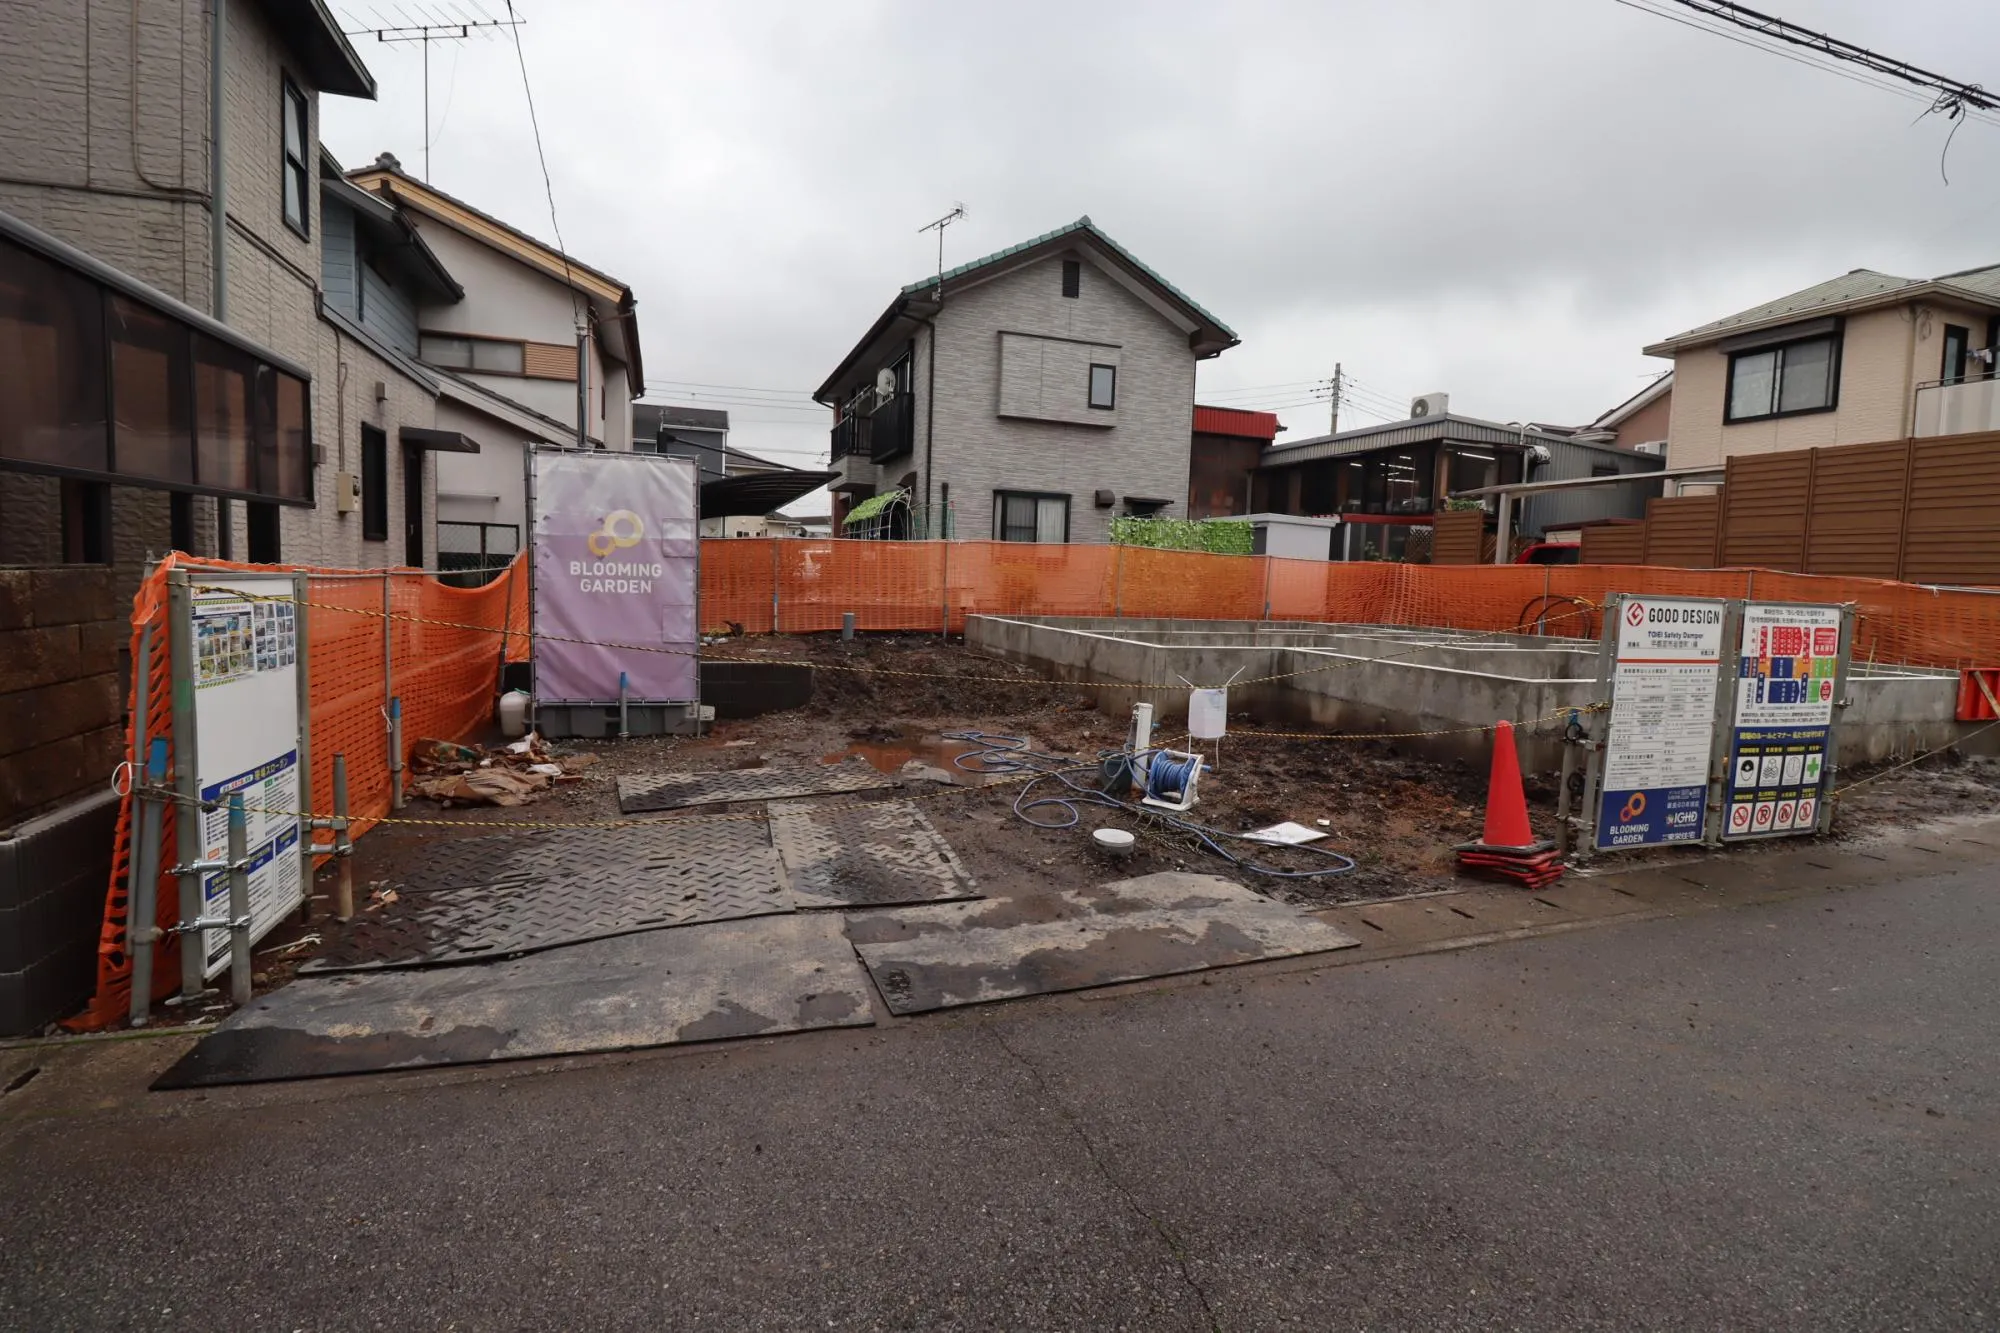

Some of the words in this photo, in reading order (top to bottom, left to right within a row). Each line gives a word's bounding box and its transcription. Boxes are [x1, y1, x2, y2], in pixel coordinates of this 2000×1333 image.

[569, 561, 663, 578] BLOOMING
[580, 579, 652, 594] GARDEN
[1648, 608, 1680, 623] GOOD
[1682, 609, 1720, 625] DESIGN
[1664, 631, 1682, 640] Safety
[1609, 824, 1650, 835] BLOOMING
[1612, 834, 1645, 845] GARDEN
